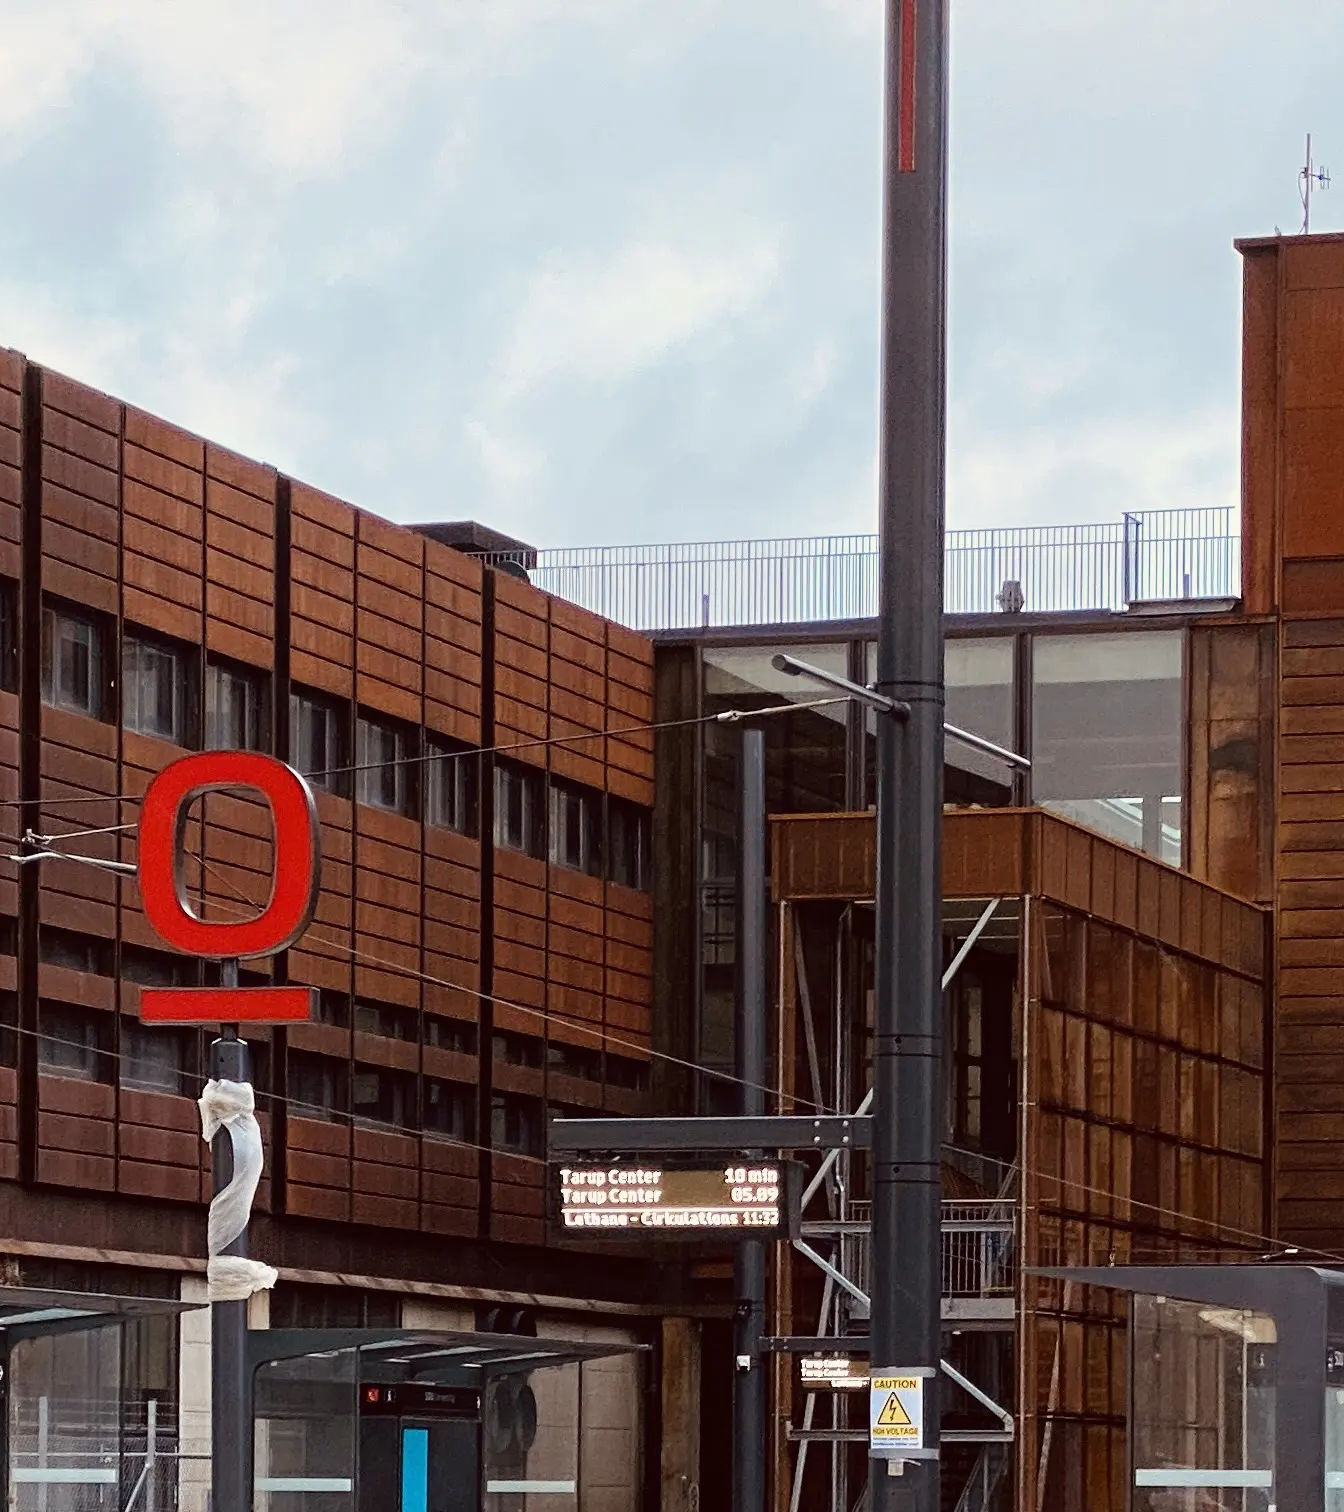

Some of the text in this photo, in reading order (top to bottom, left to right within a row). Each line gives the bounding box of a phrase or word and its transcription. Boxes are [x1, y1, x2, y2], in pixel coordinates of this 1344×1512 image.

[560, 1168, 778, 1186] Tarup Center 10 min
[561, 1188, 606, 1205] Tarup
[609, 1188, 662, 1203] Center
[874, 1379, 917, 1389] CAUTION
[886, 1427, 918, 1436] VOLTAGE
